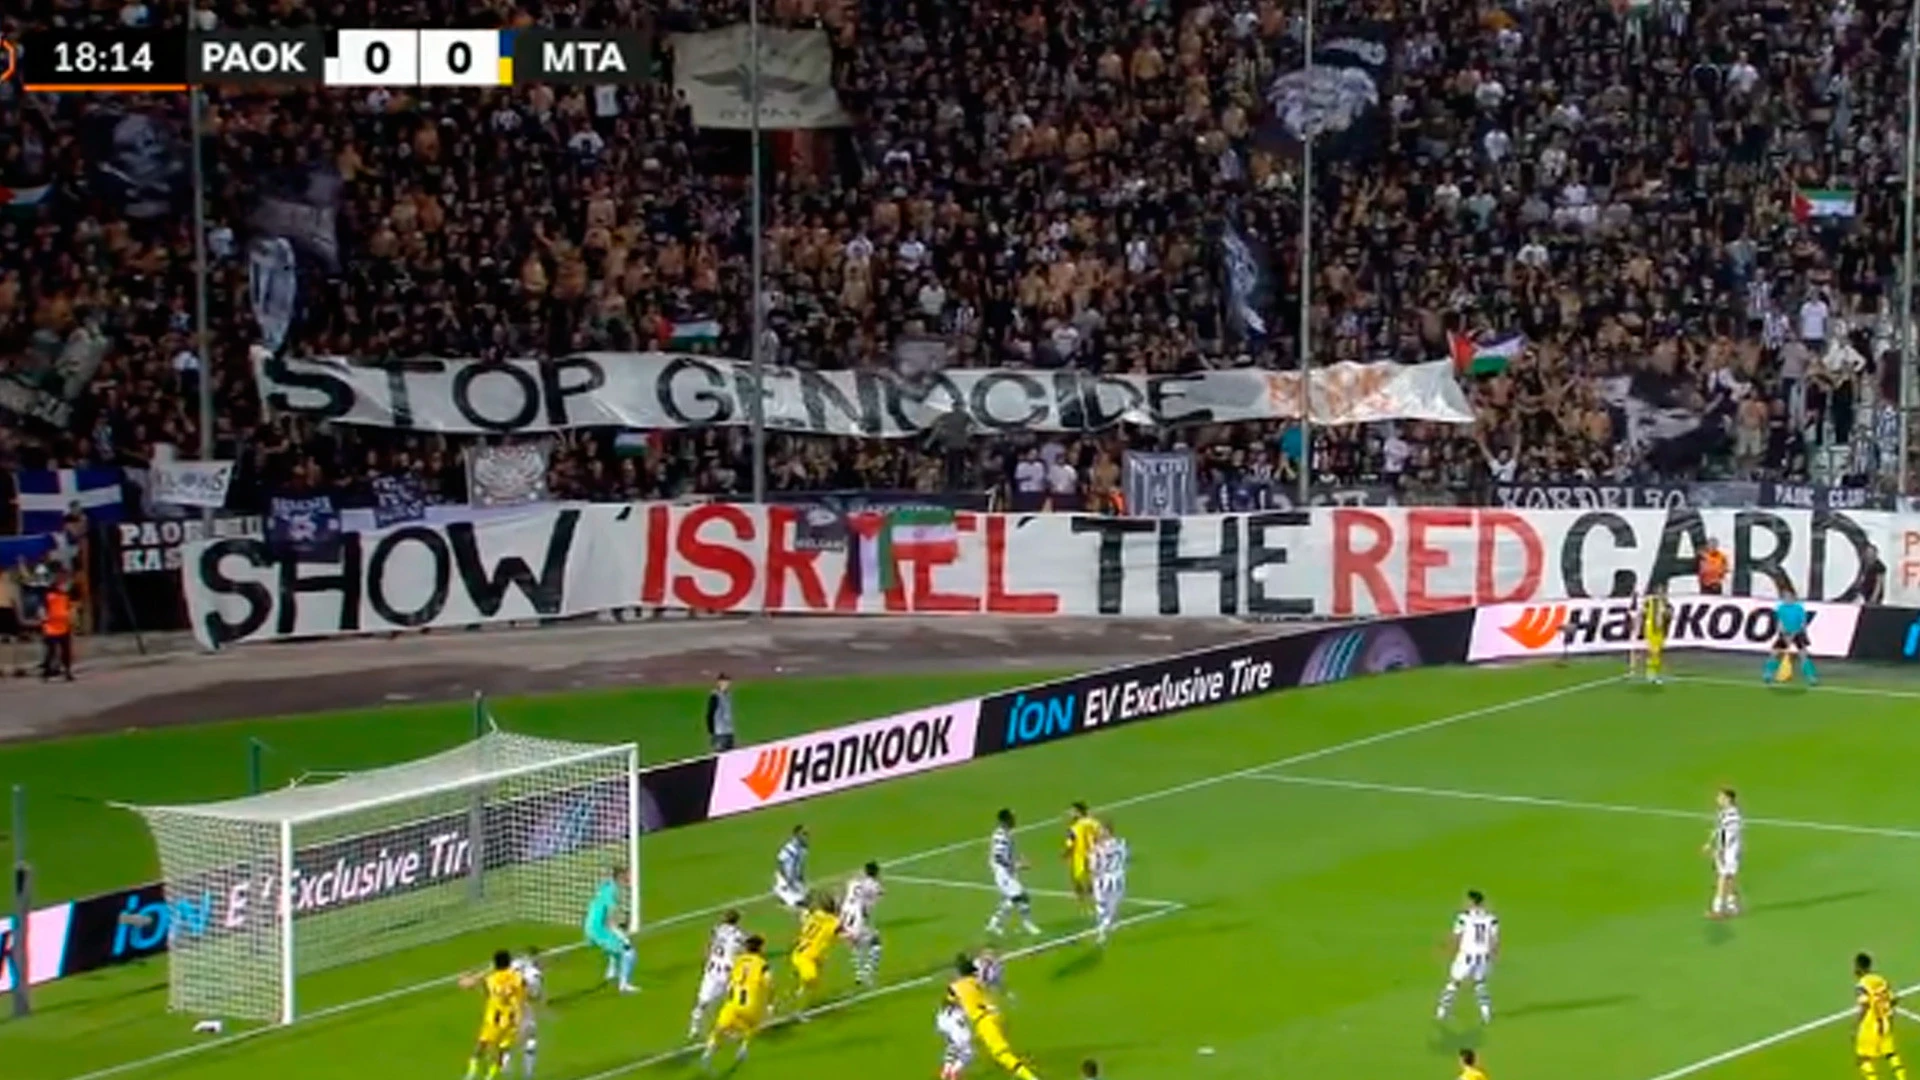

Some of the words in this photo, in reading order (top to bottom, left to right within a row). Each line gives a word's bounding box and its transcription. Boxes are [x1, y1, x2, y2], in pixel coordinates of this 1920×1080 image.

[264, 348, 605, 430] STOP
[656, 357, 1214, 433] GENOCIDE
[199, 509, 582, 650] SHOW
[1071, 512, 1314, 614] THE
[1332, 508, 1544, 614] RED
[1561, 502, 1872, 602] CARD
[1083, 690, 1122, 728] EV
[1120, 669, 1223, 721] Exclusive
[1230, 658, 1274, 693] Tire
